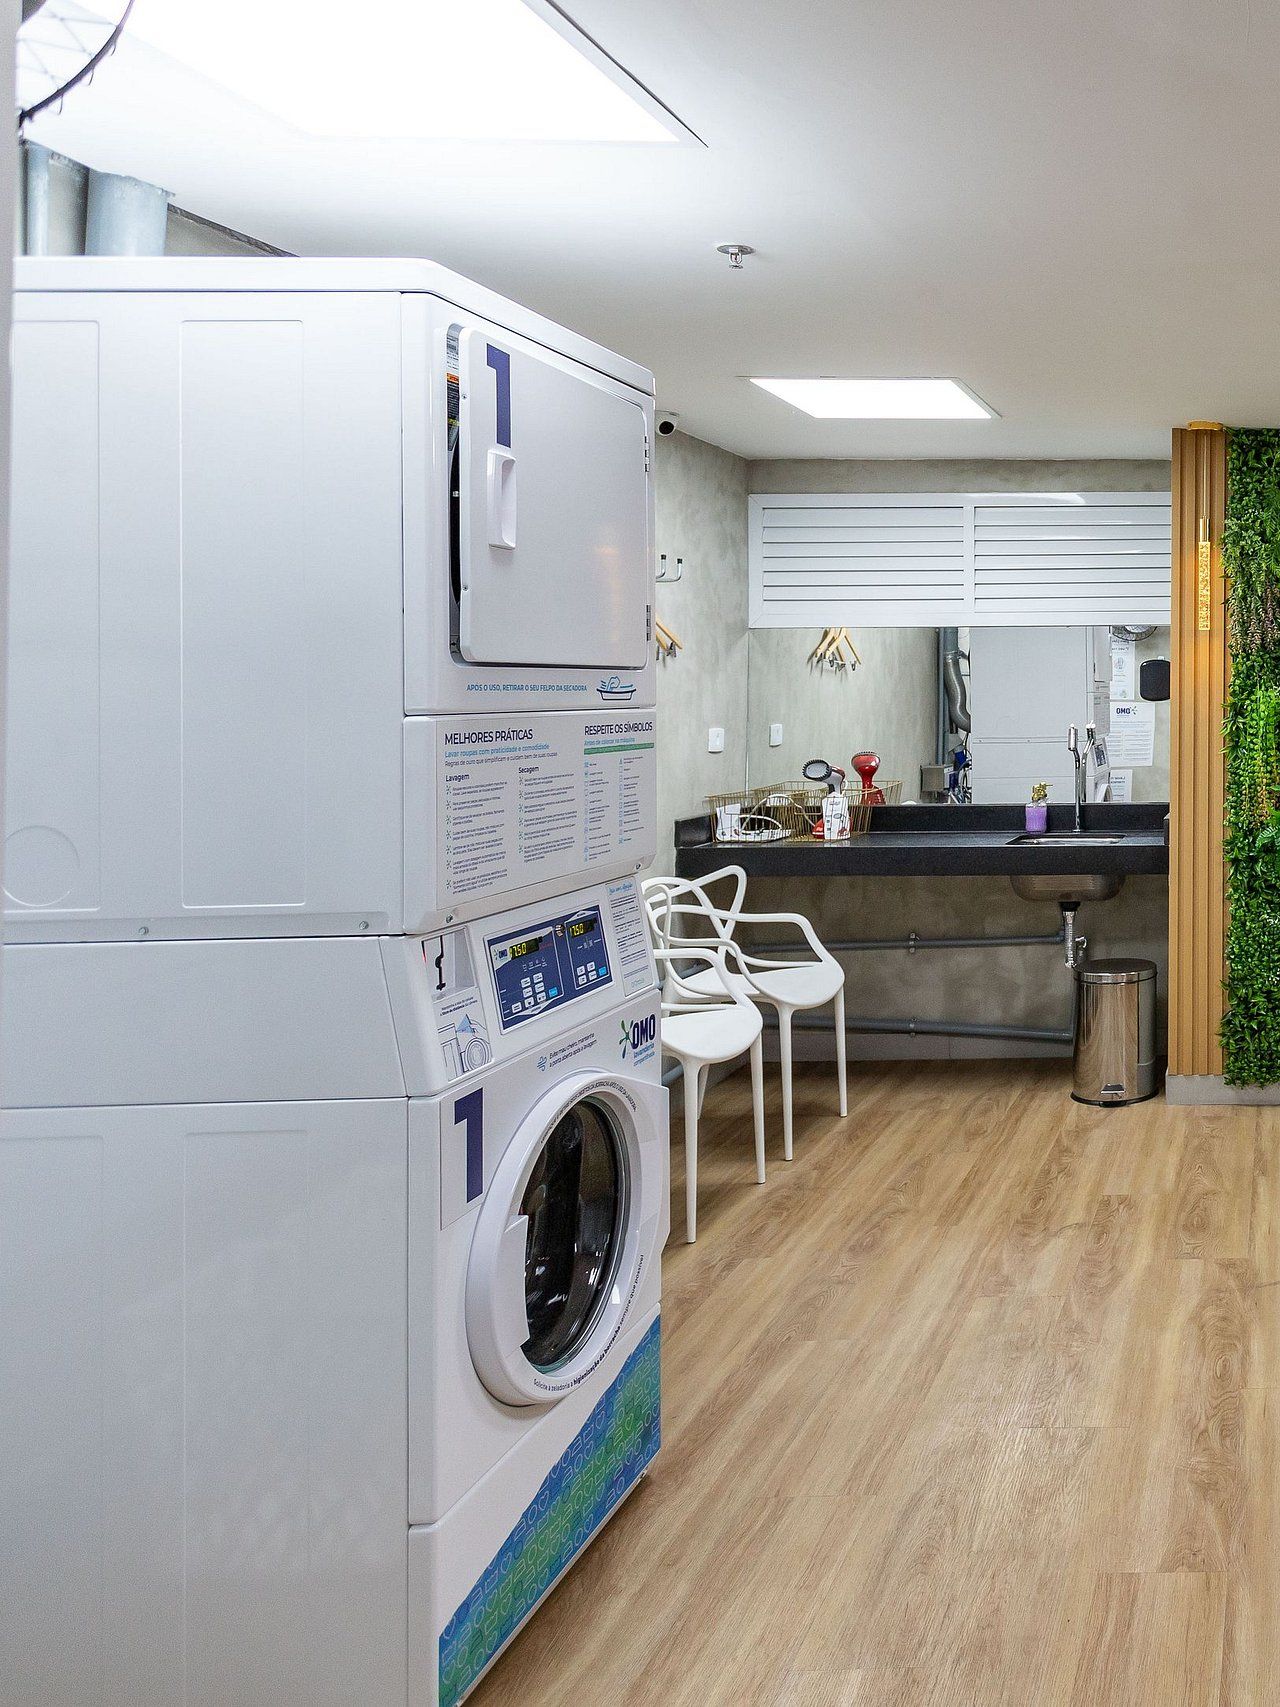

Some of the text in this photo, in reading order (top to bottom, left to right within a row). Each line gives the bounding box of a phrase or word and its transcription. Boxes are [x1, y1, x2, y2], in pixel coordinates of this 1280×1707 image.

[486, 343, 511, 448] 1
[444, 728, 533, 745] MELHORES PRÁTICAS
[584, 721, 653, 736] RESPEITE OS SÍMBOLOS
[445, 773, 470, 783] Lavagem
[518, 766, 539, 775] Secagem
[631, 1014, 656, 1049] OMO
[454, 1087, 483, 1203] 1
